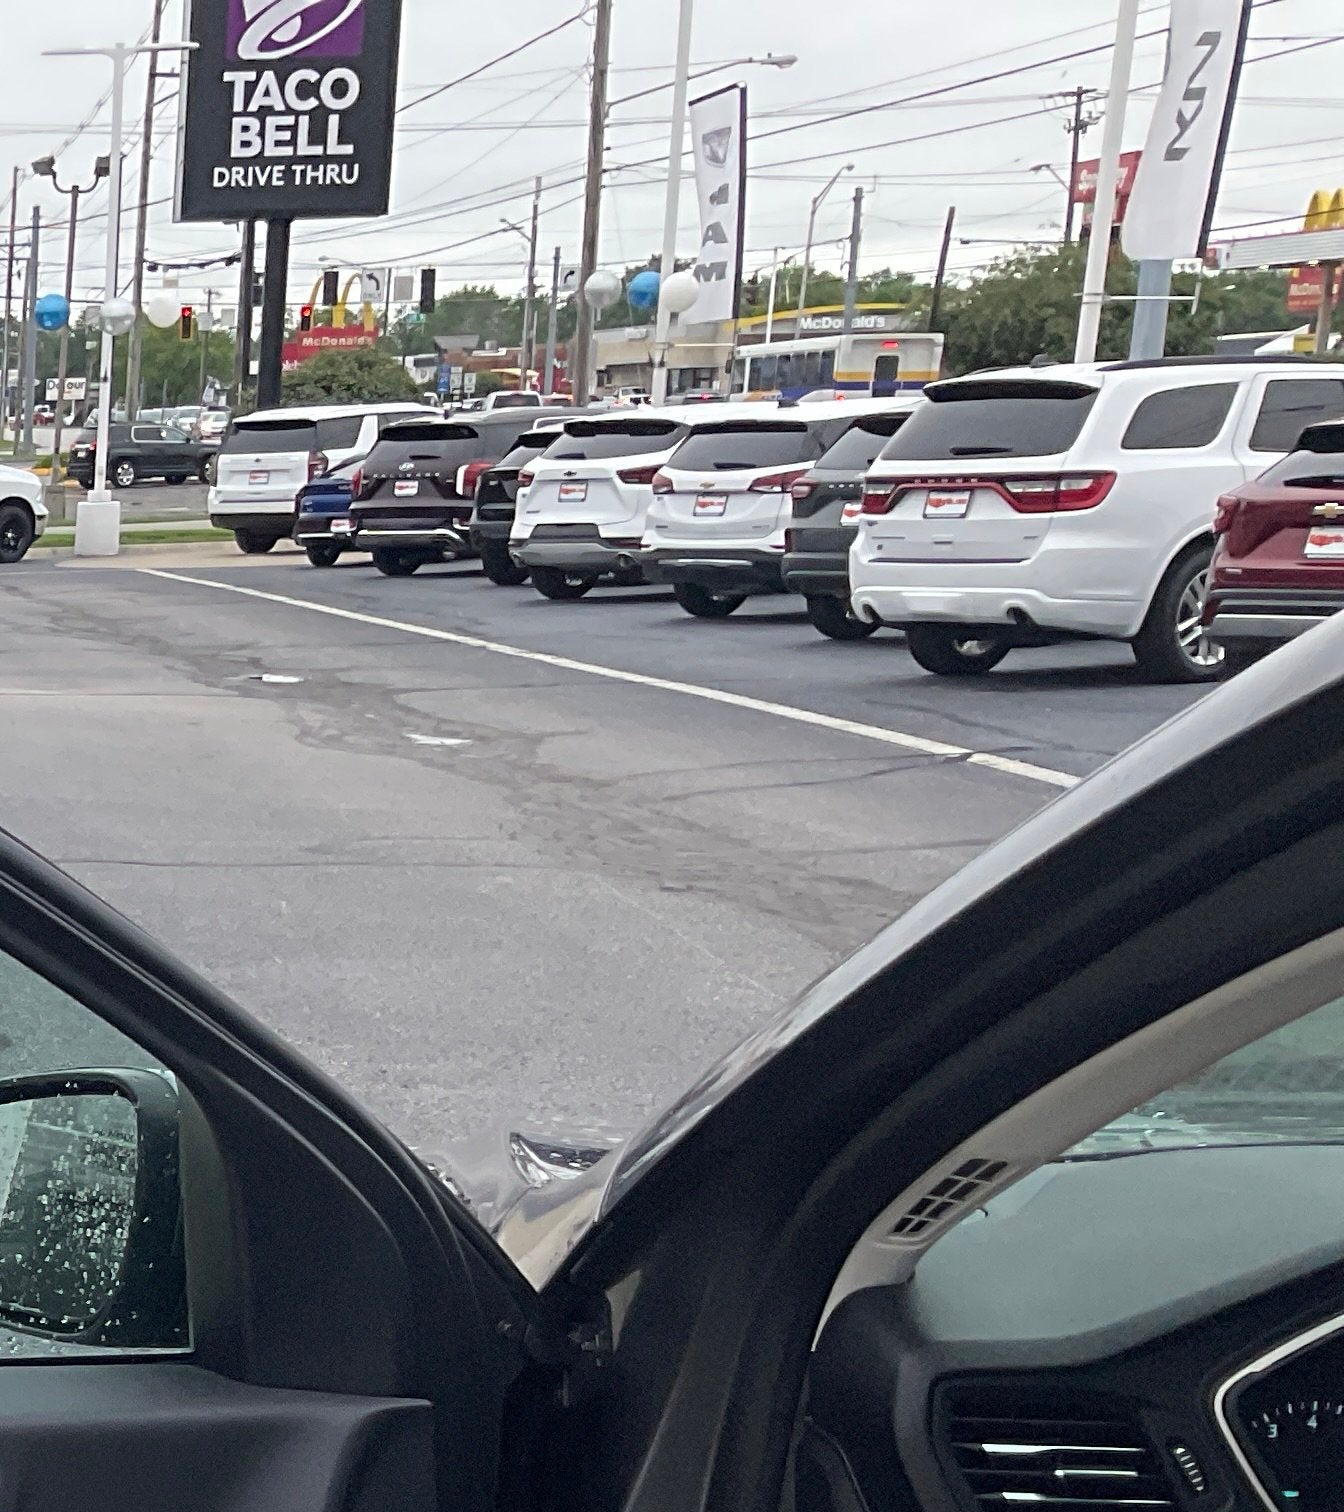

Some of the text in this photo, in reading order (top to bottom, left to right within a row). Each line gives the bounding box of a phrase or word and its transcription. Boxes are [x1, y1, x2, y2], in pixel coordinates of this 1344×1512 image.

[222, 67, 361, 112] TACO
[230, 113, 354, 158] BELL
[213, 162, 359, 188] DRIVE THRU
[1267, 1423, 1279, 1438] 3
[1307, 1414, 1318, 1429] 4
